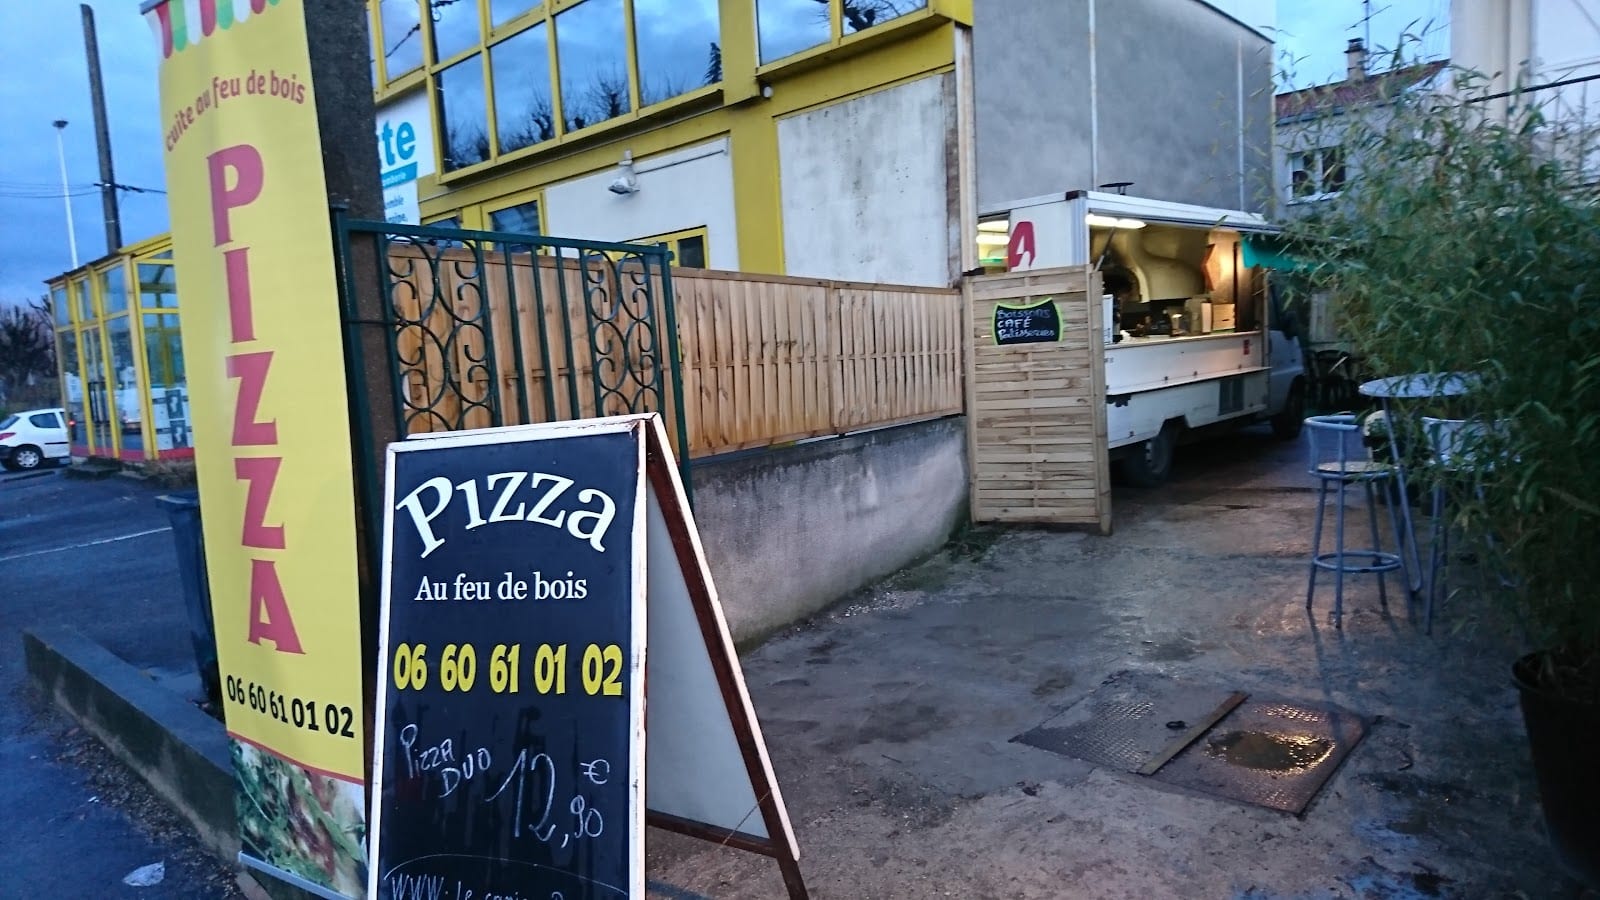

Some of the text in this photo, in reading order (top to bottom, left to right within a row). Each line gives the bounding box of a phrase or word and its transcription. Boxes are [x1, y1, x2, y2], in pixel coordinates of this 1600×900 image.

[165, 69, 305, 152] cuite au feu de bois
[381, 121, 416, 166] te
[997, 316, 1032, 328] CAFÉ
[206, 144, 306, 655] PIZZA
[395, 471, 617, 559] Pizza
[414, 571, 588, 600] Au feu de bois
[394, 643, 623, 695] 06 60 61 01 02
[227, 675, 354, 738] 06 60 61 01 02
[439, 748, 491, 798] DUO
